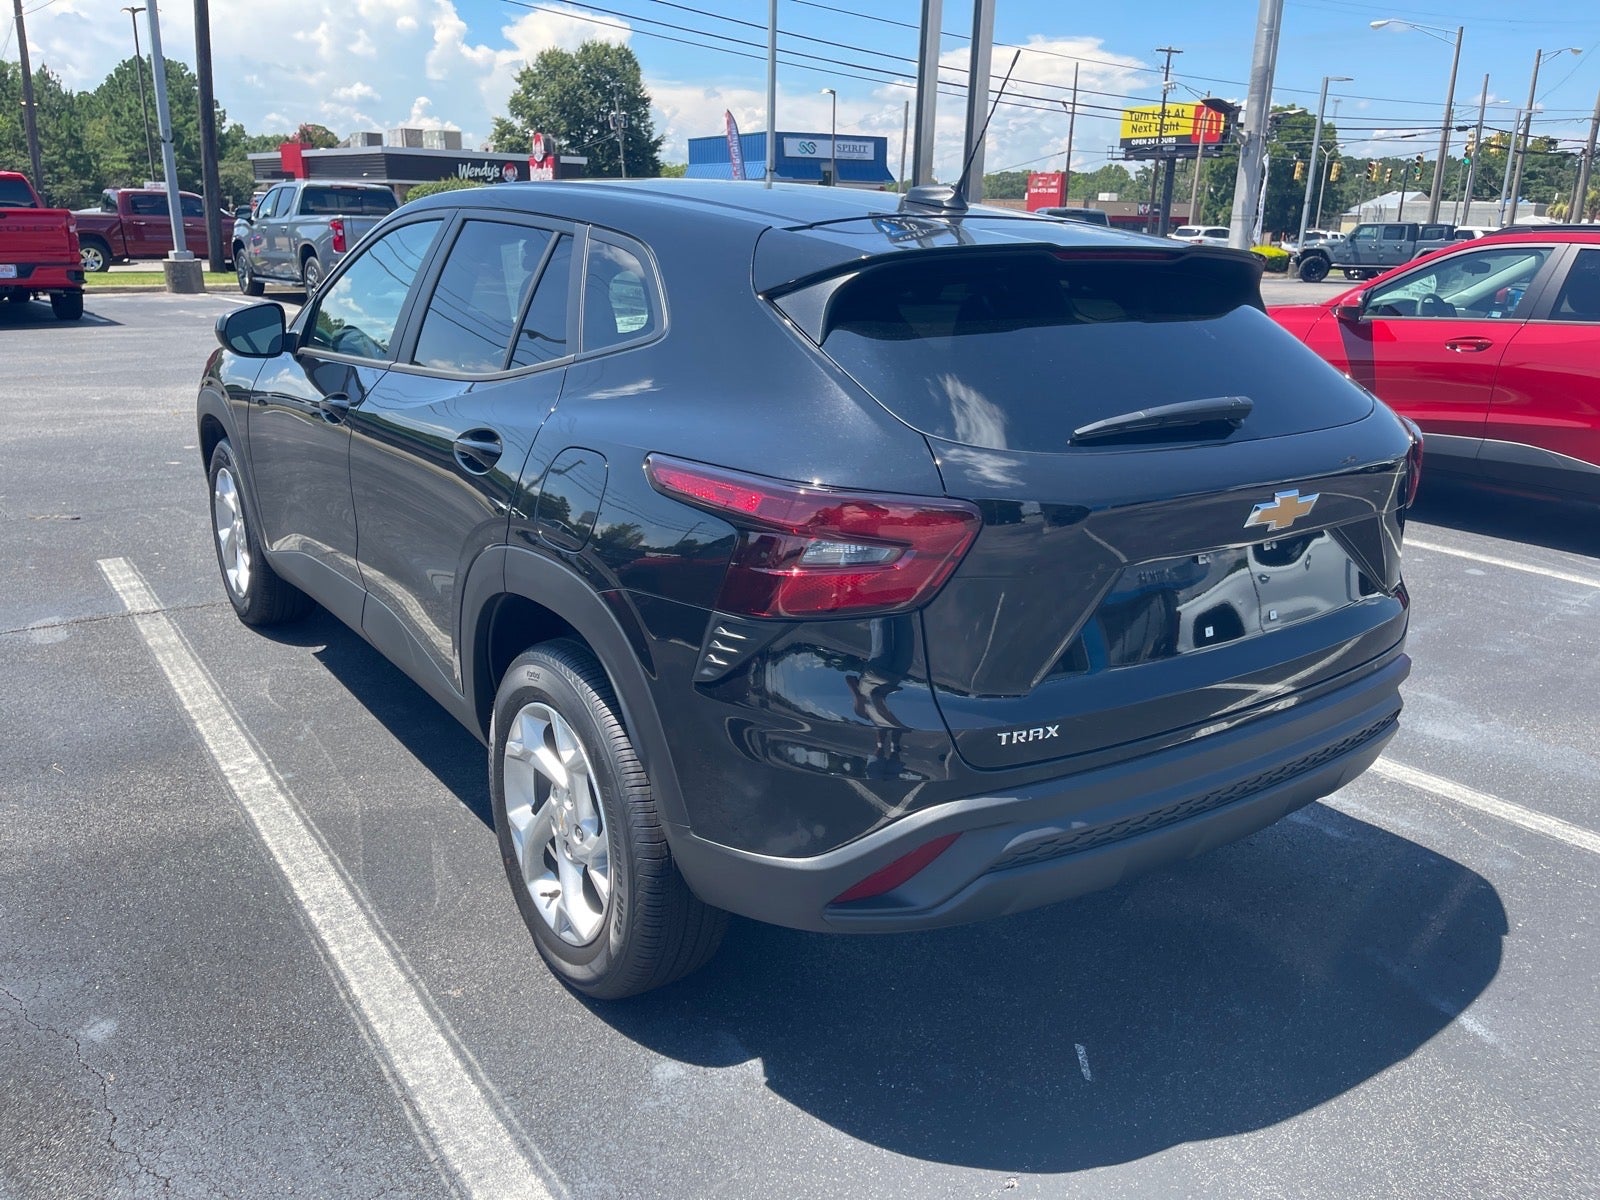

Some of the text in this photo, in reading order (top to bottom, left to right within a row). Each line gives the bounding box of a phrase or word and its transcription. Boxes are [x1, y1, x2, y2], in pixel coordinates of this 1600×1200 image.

[1129, 108, 1185, 121] Turn Let At
[1131, 121, 1180, 133] Next Lght
[836, 144, 868, 153] SPIRIT
[458, 161, 500, 181] Wendy's
[997, 724, 1060, 746] TRAX
